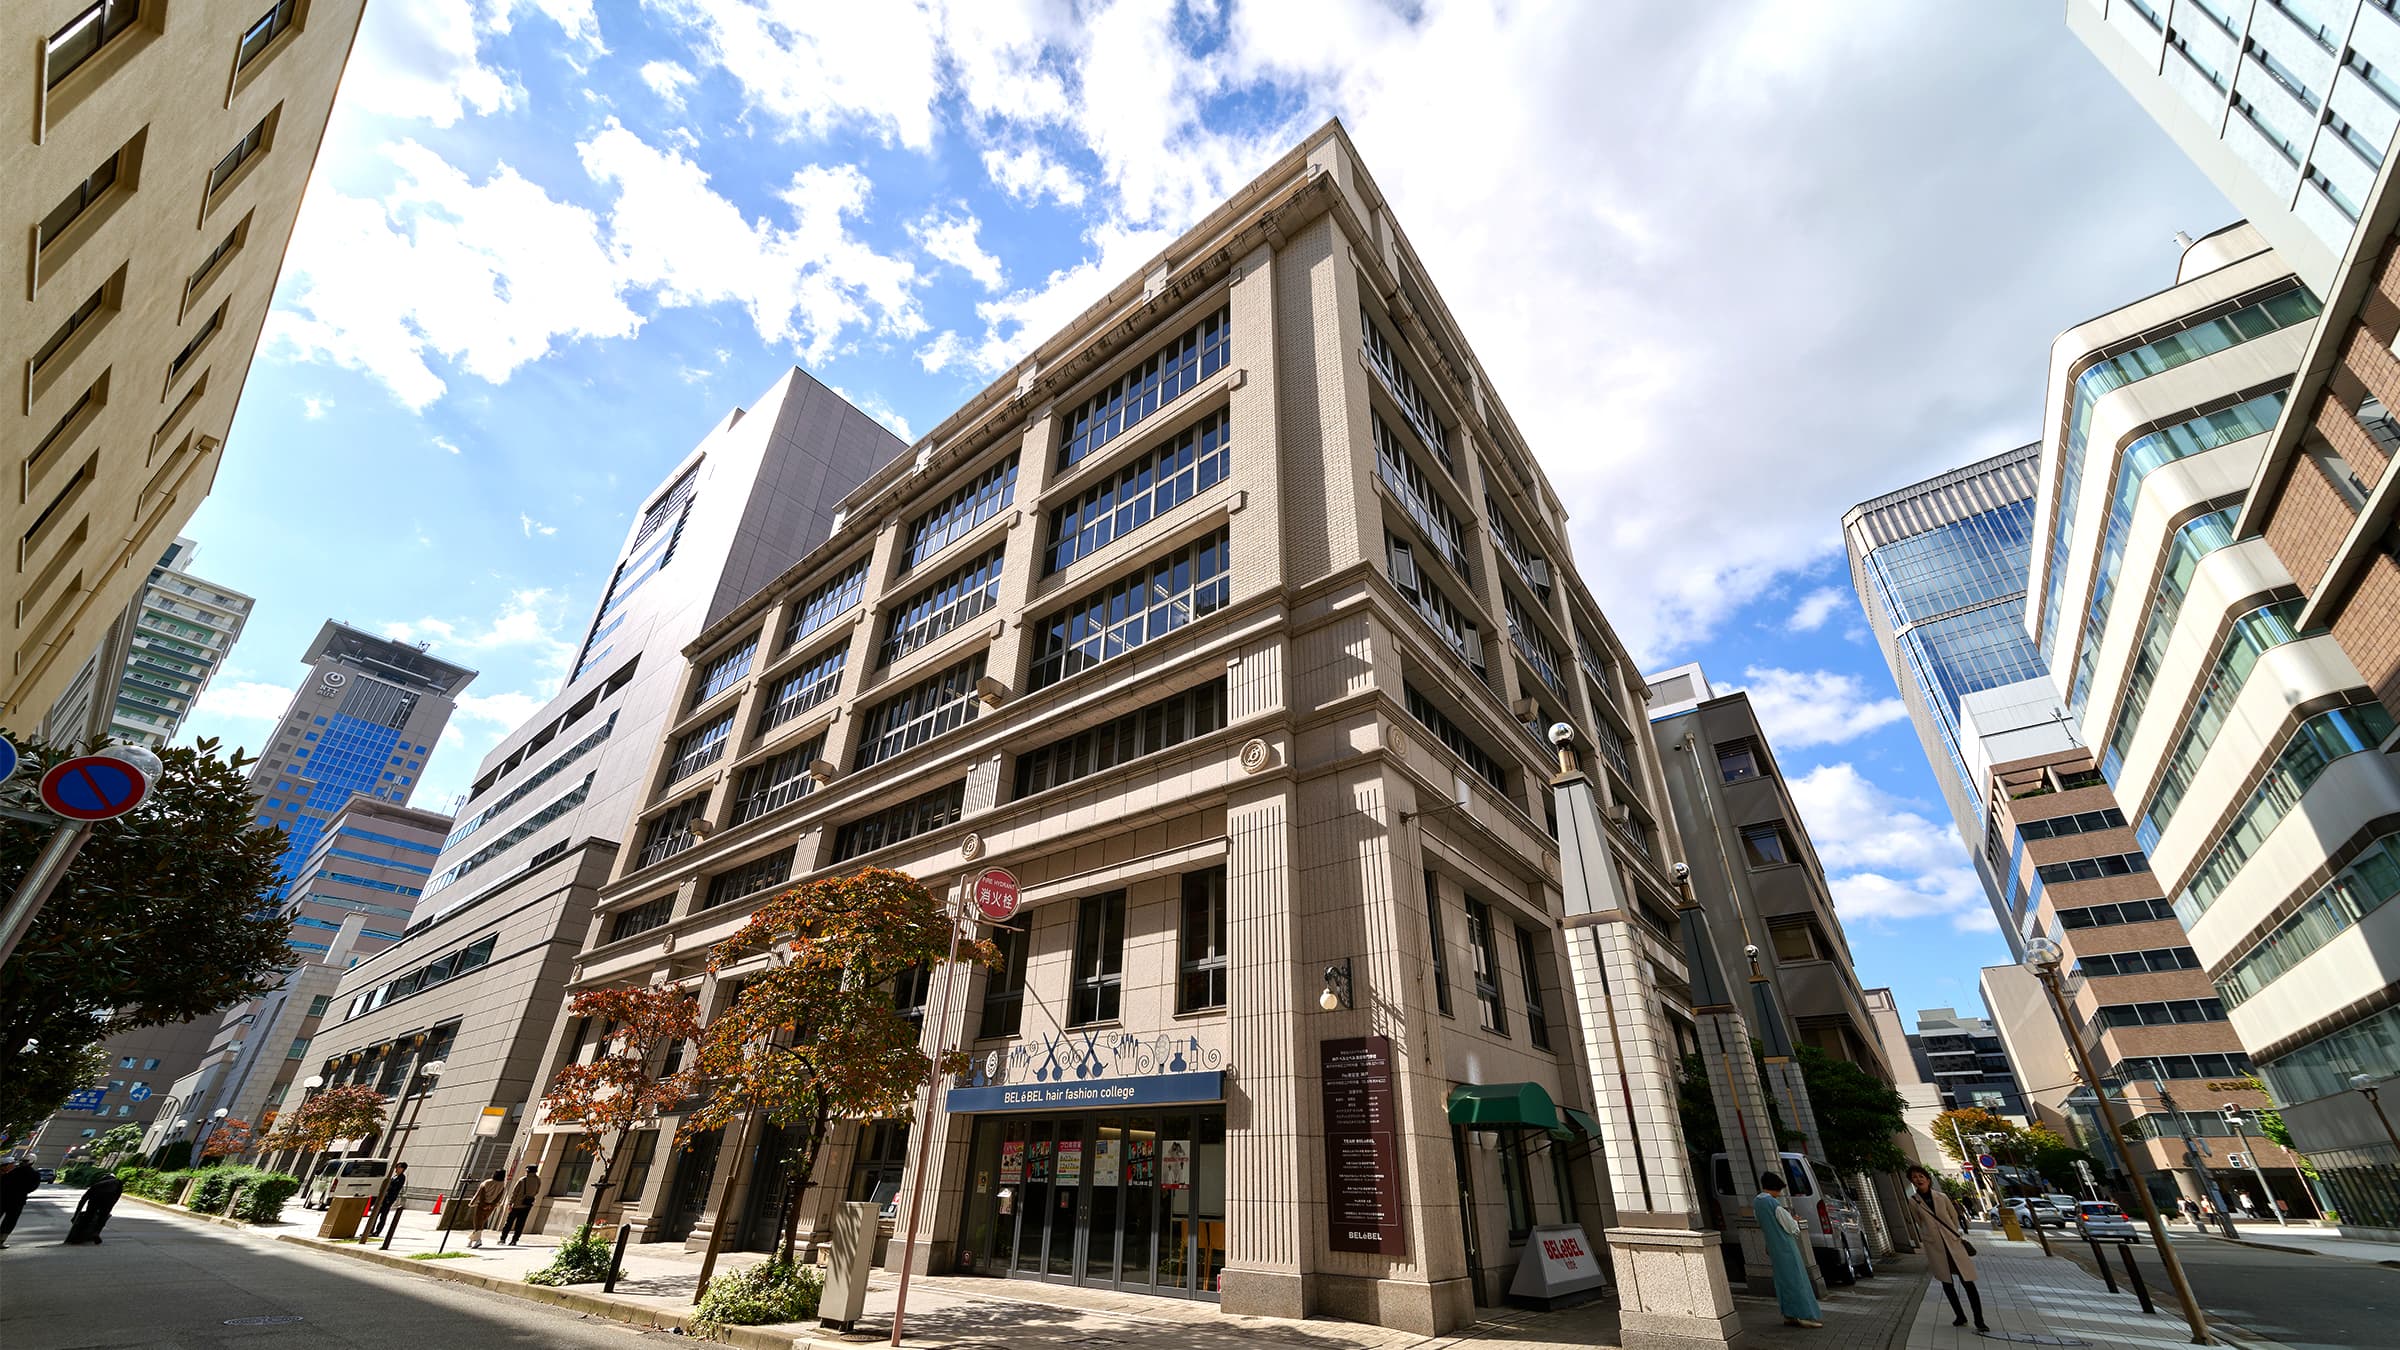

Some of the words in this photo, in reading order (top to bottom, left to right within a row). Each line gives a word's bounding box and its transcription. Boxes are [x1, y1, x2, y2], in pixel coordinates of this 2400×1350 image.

[993, 880, 1015, 889] HYDRANT
[980, 887, 1013, 910] 消火栓
[1045, 1089, 1064, 1101] hair
[1065, 1087, 1098, 1100] fashion
[1100, 1085, 1135, 1099] college
